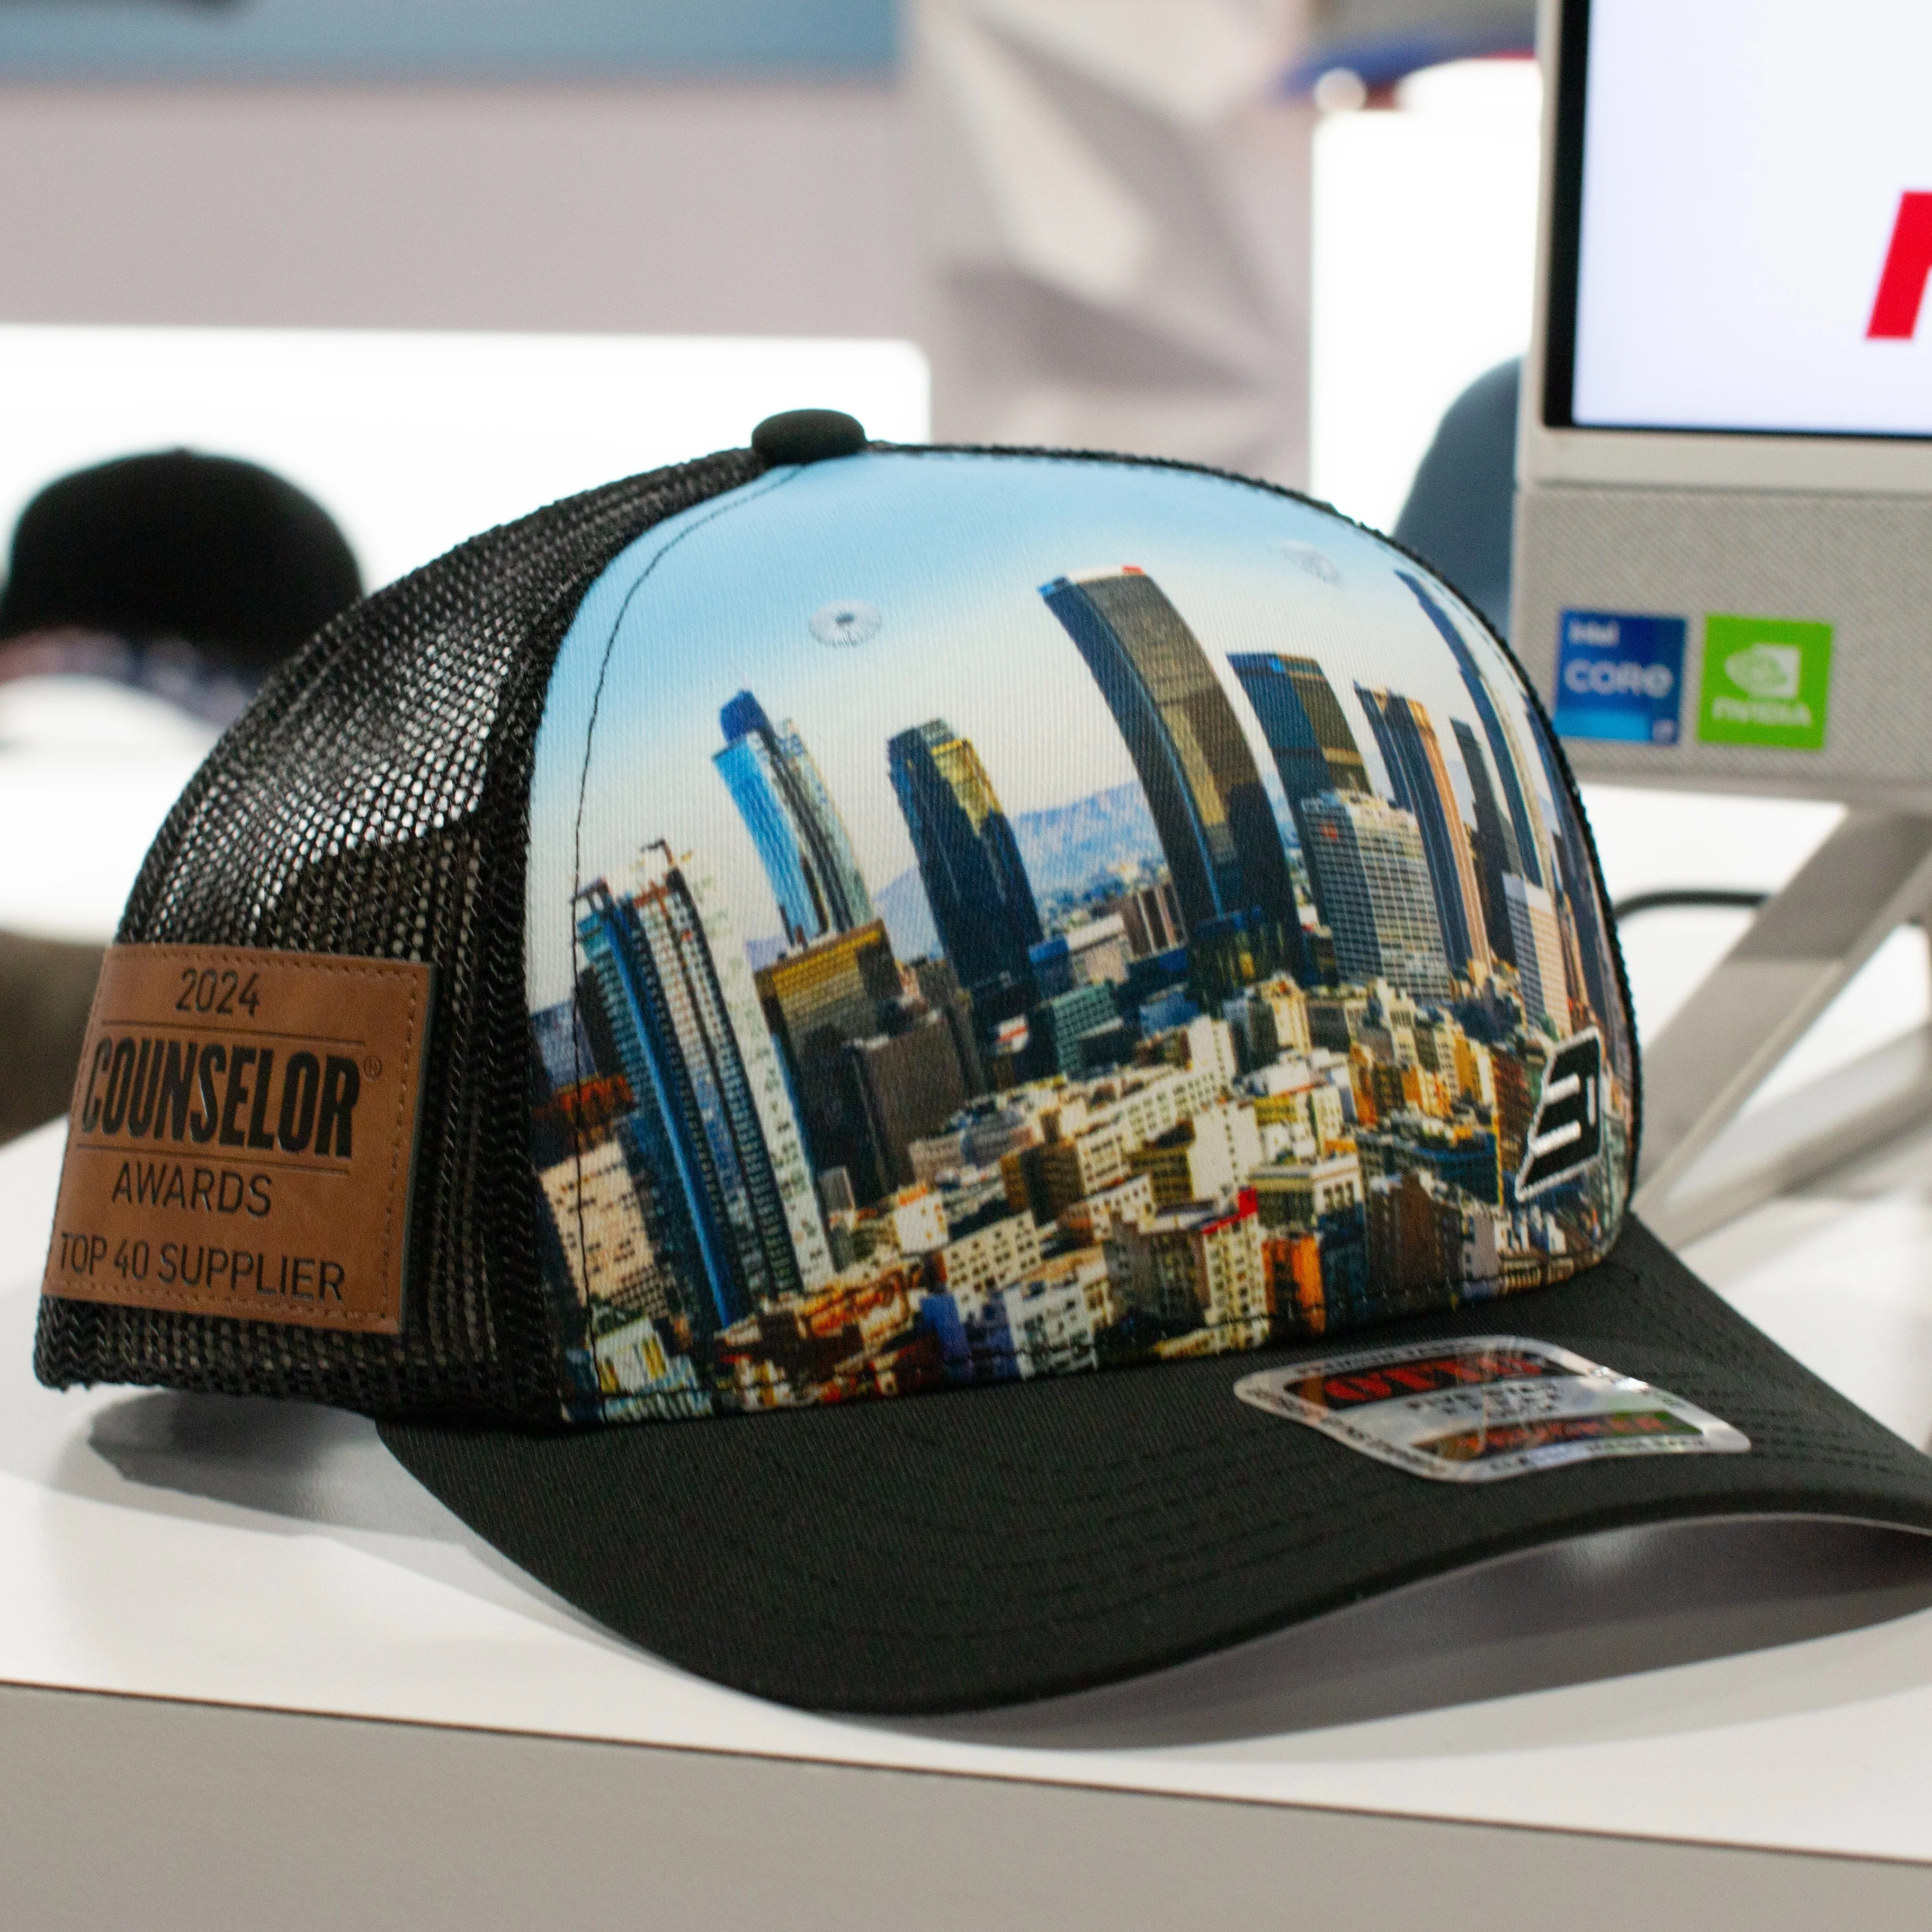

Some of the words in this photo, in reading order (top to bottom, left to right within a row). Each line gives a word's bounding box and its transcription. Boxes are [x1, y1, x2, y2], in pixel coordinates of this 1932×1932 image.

[175, 968, 261, 1017] 2024
[111, 1160, 273, 1219] AWARDS
[60, 1231, 108, 1277] TOP
[113, 1240, 150, 1282] 40
[158, 1241, 346, 1306] SUPPLIER
